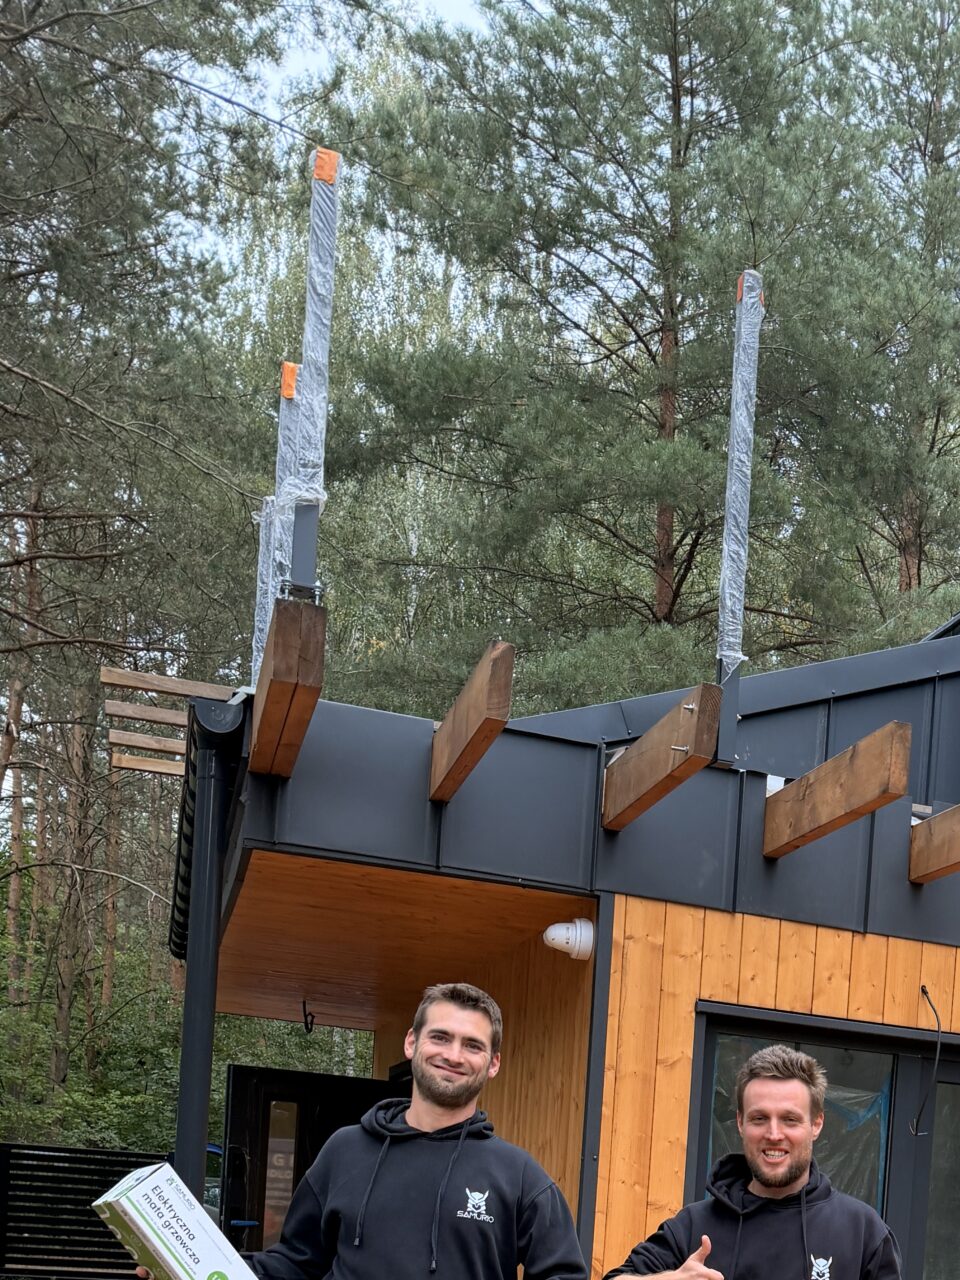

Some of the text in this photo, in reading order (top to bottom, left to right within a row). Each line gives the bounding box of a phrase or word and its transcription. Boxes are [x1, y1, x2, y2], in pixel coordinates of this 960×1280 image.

[142, 1193, 165, 1219] mata
[161, 1220, 201, 1265] grzewcza
[151, 1185, 196, 1241] Elektryczna
[456, 1210, 495, 1223] SAMURIO
